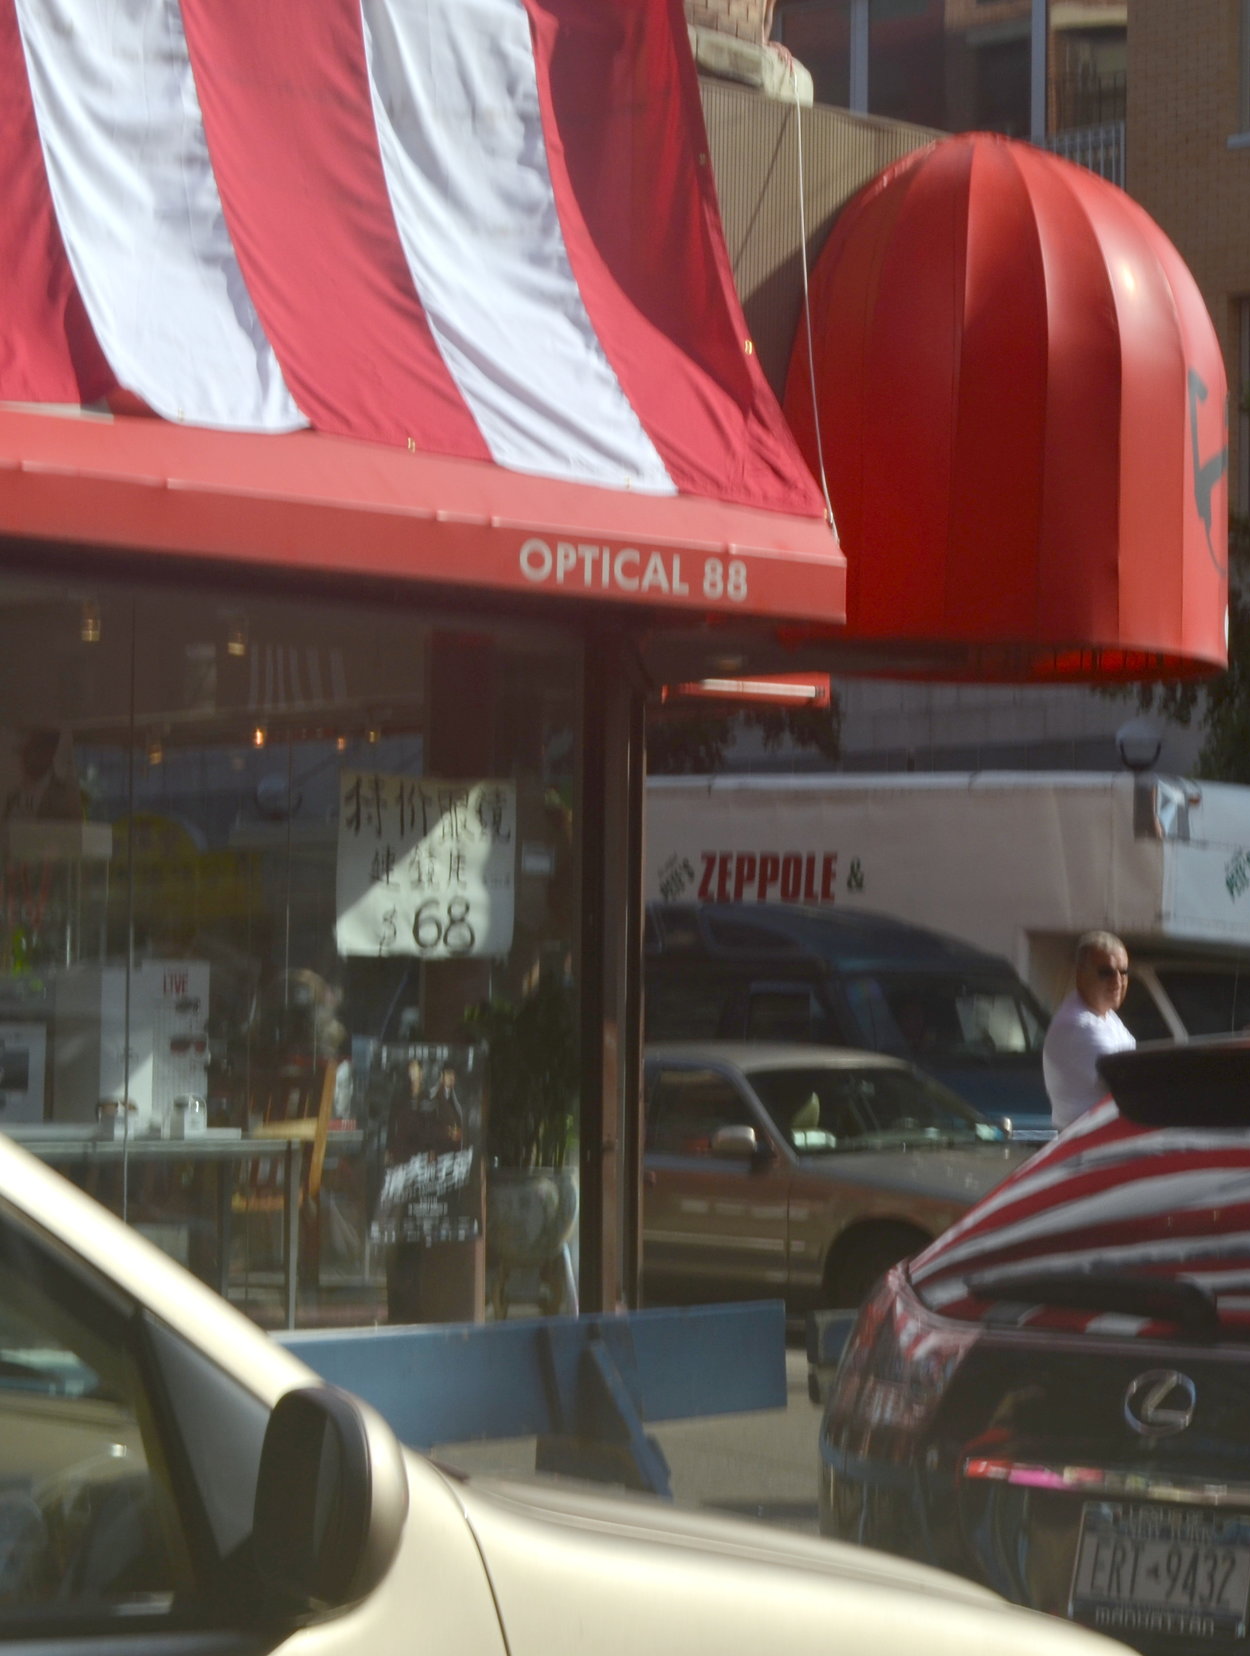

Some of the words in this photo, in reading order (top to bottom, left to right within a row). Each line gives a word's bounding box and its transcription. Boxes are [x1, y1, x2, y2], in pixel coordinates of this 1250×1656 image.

[519, 537, 689, 597] OPTICAL
[702, 556, 748, 602] 88
[698, 850, 838, 904] ZEPPOLE
[847, 856, 864, 893] &
